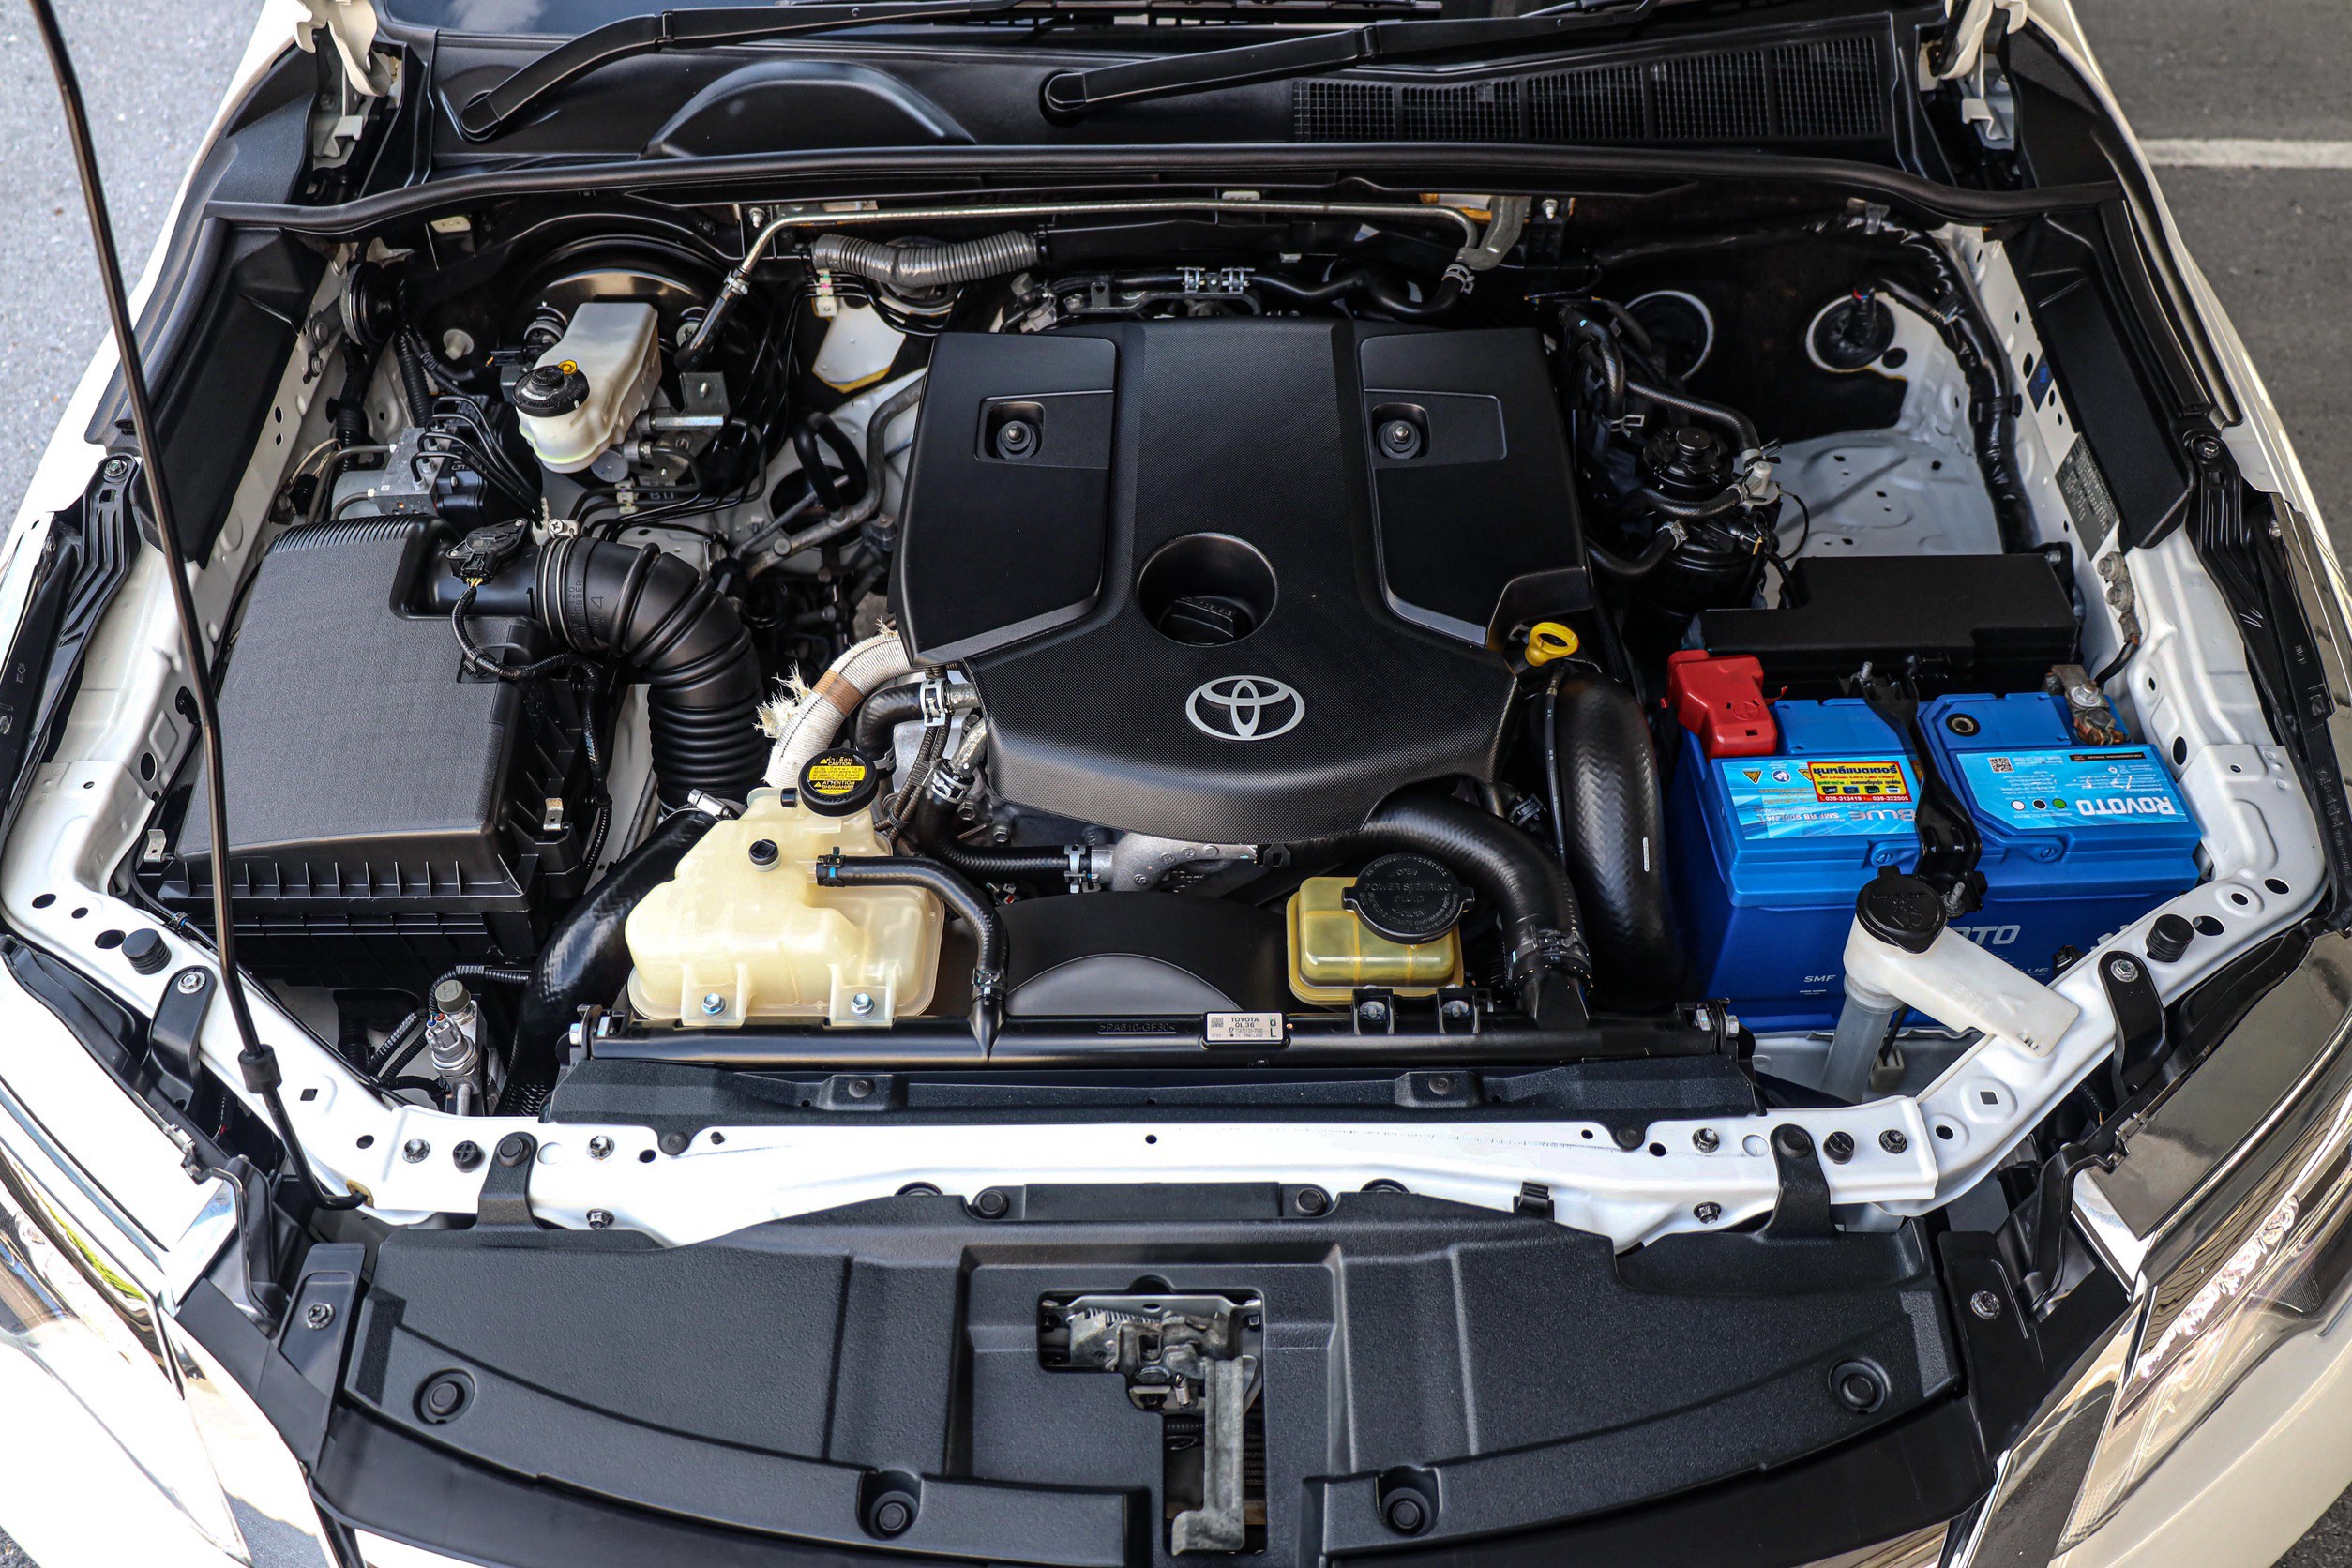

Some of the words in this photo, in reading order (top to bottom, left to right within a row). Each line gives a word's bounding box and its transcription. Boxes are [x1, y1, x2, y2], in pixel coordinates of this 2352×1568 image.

[2075, 796, 2175, 816] ROVOTO
[1848, 808, 1916, 822] BLUE
[1364, 882, 1401, 891] POWER
[1803, 974, 1836, 983] SMF
